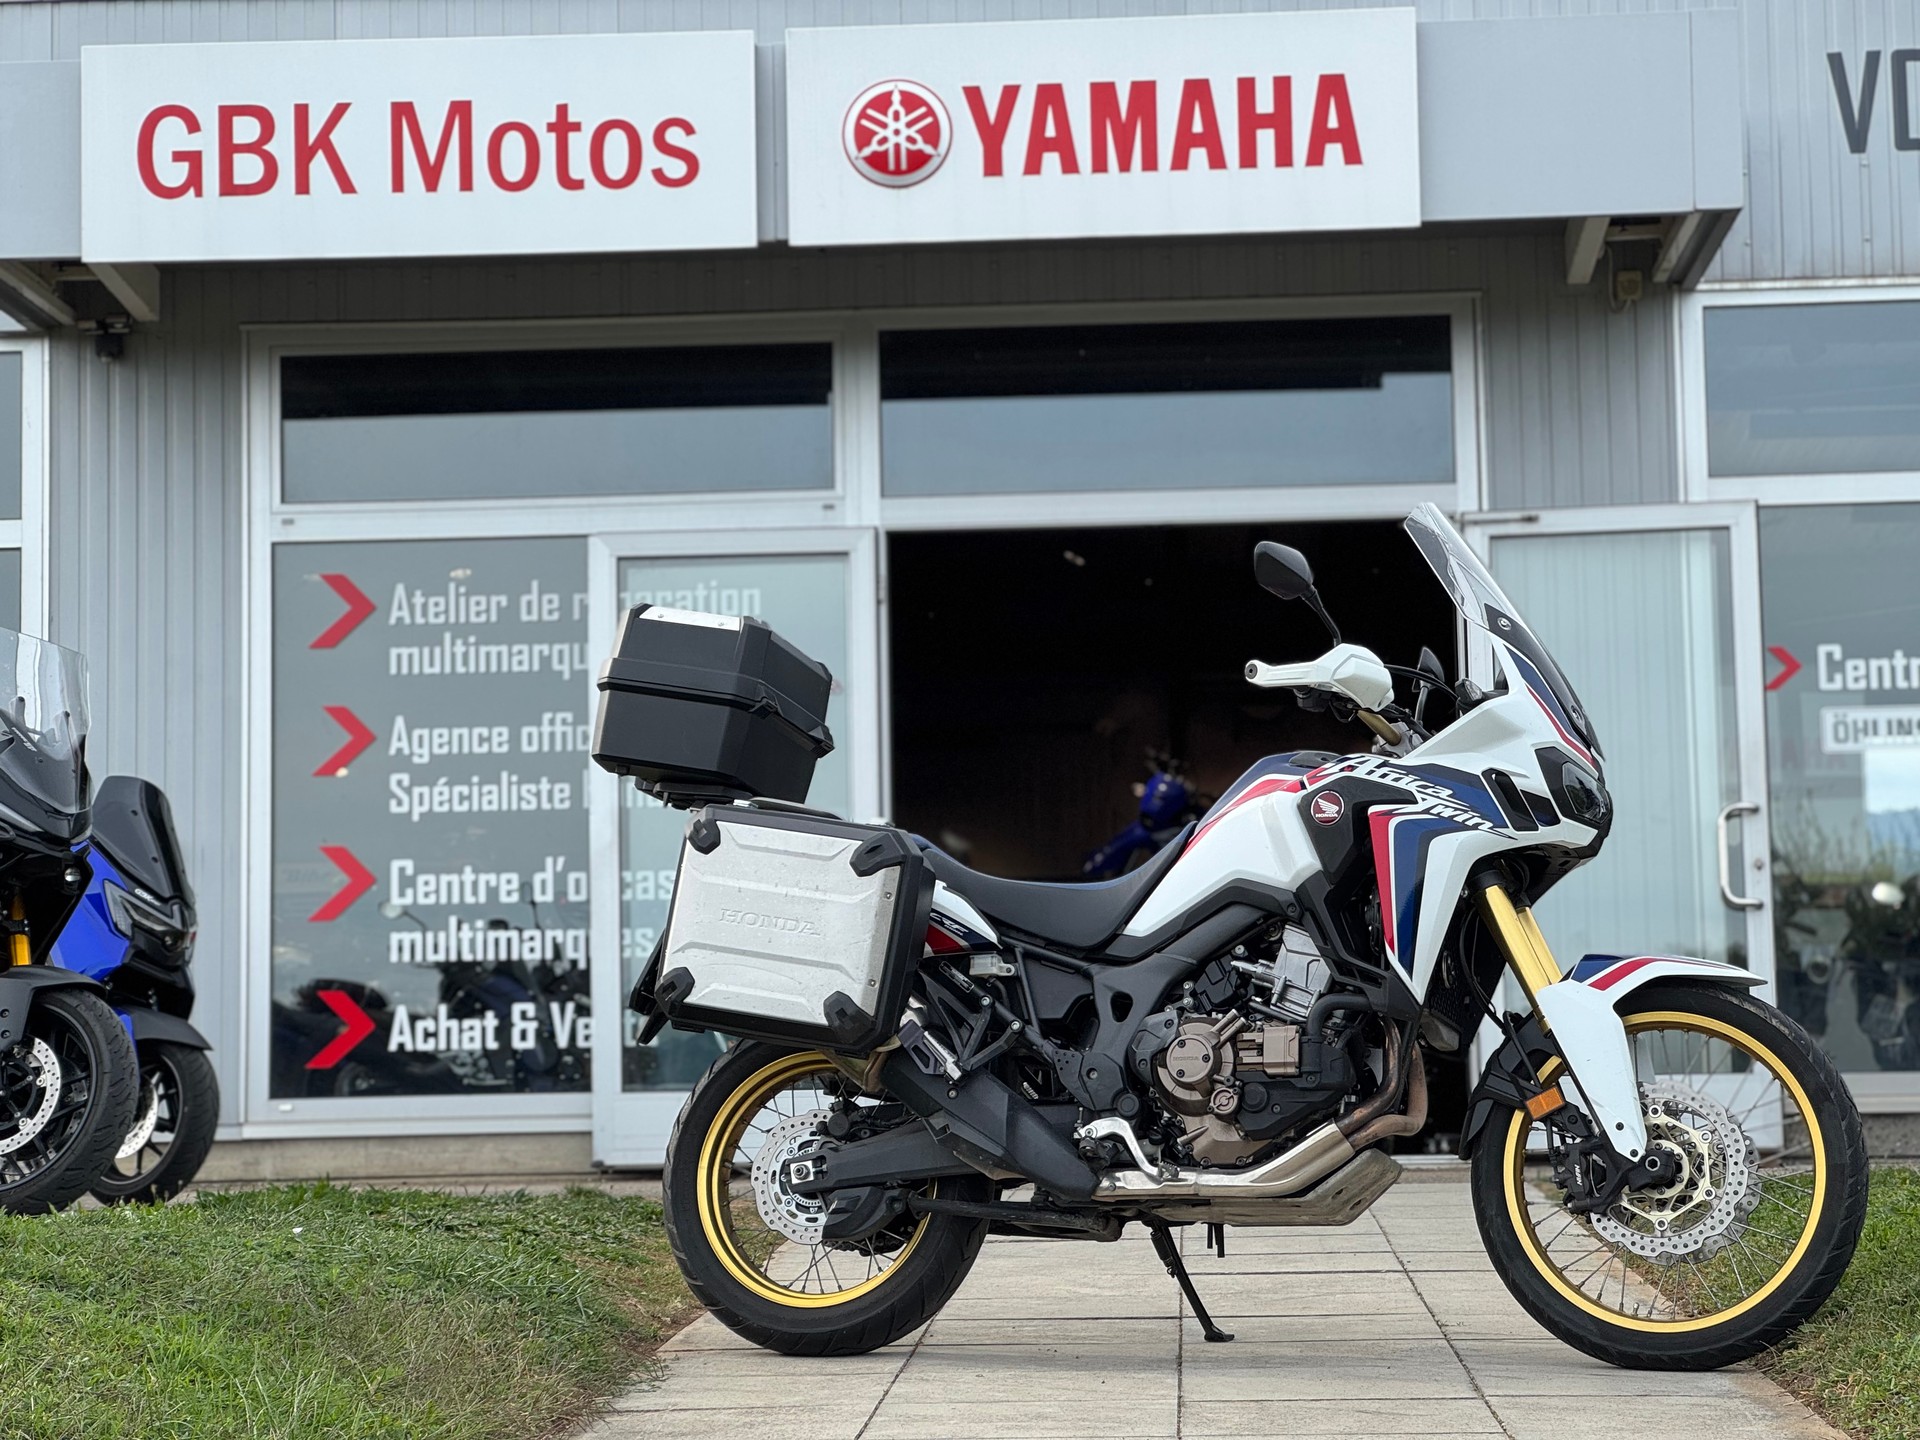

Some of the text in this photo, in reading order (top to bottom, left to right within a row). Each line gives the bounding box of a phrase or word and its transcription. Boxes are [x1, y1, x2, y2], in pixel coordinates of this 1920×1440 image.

[136, 100, 700, 200] GBK Motos
[961, 73, 1363, 178] YAMAHA
[388, 581, 507, 625] Atelier
[520, 580, 560, 622] de
[388, 711, 589, 764] Agence offic
[1833, 712, 1920, 744] ÖHLIN
[388, 770, 572, 822] Spécialiste
[1317, 754, 1456, 802] Africa
[389, 859, 520, 905] Centre
[388, 915, 655, 971] multimarqes
[720, 908, 821, 936] HONDA
[387, 1003, 500, 1052] Achat
[511, 1001, 539, 1050] &
